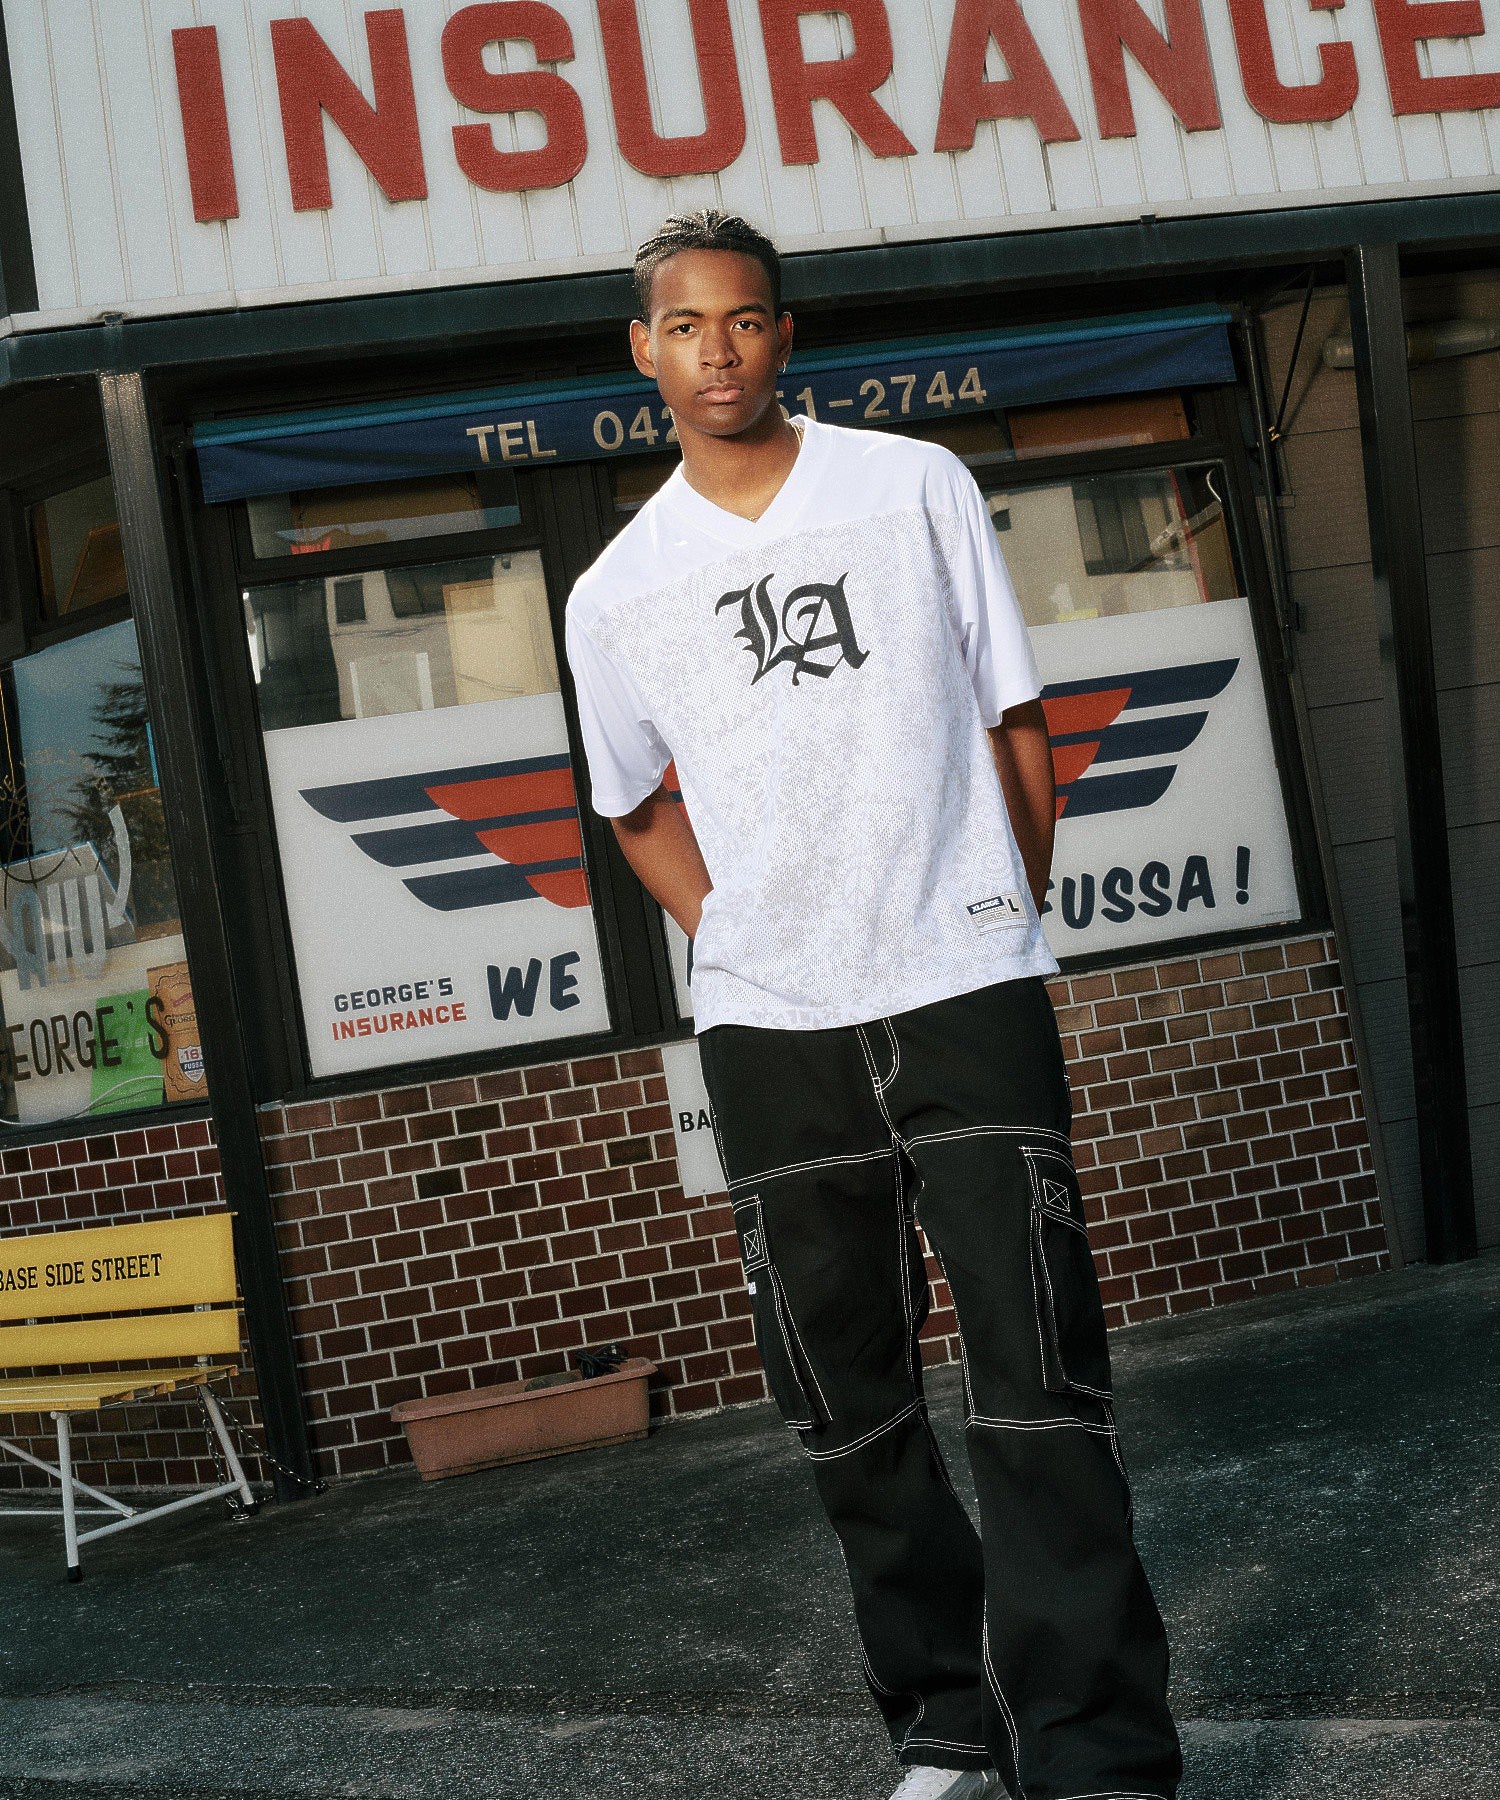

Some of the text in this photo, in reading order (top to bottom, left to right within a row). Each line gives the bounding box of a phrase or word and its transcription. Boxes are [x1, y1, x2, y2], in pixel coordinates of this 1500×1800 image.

[171, 0, 1500, 223] INSURANCE
[466, 420, 557, 463] TEL
[971, 899, 1001, 913] XLARGE
[1007, 898, 1020, 913] L
[1042, 854, 1216, 930] USSA
[334, 977, 454, 1012] GEORGE'S
[487, 950, 581, 1021] WE
[332, 1002, 467, 1041] INSURANCE
[45, 1261, 85, 1288] SIDE
[91, 1253, 162, 1283] STREET
